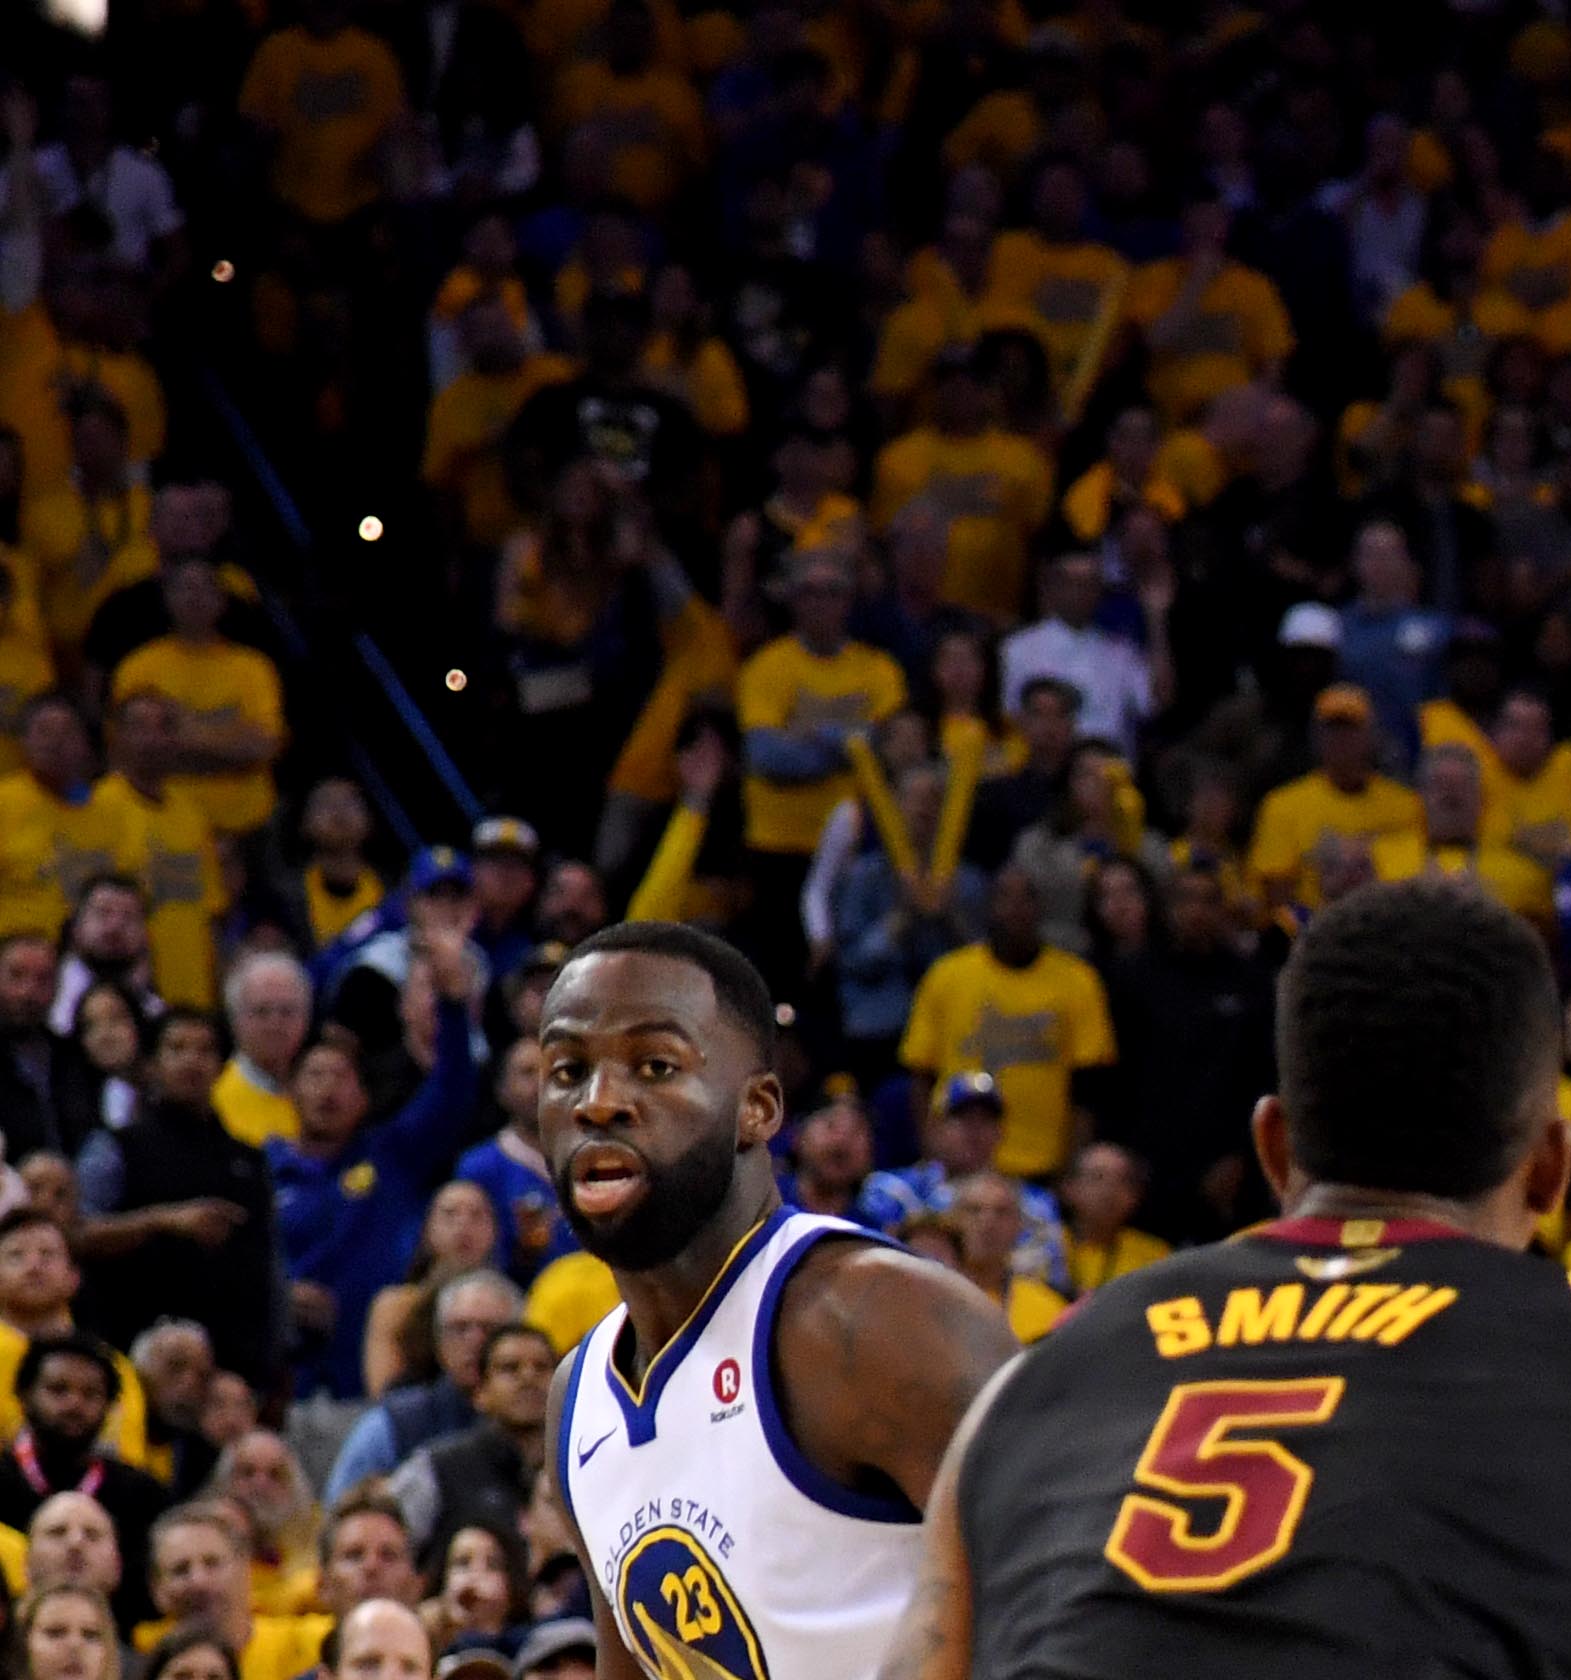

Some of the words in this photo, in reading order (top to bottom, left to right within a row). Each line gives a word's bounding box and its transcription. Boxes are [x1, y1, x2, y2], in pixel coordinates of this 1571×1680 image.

[1146, 1281, 1459, 1358] SMITH
[1104, 1375, 1347, 1592] 5
[669, 1497, 736, 1561] STATE
[659, 1564, 722, 1643] 23
